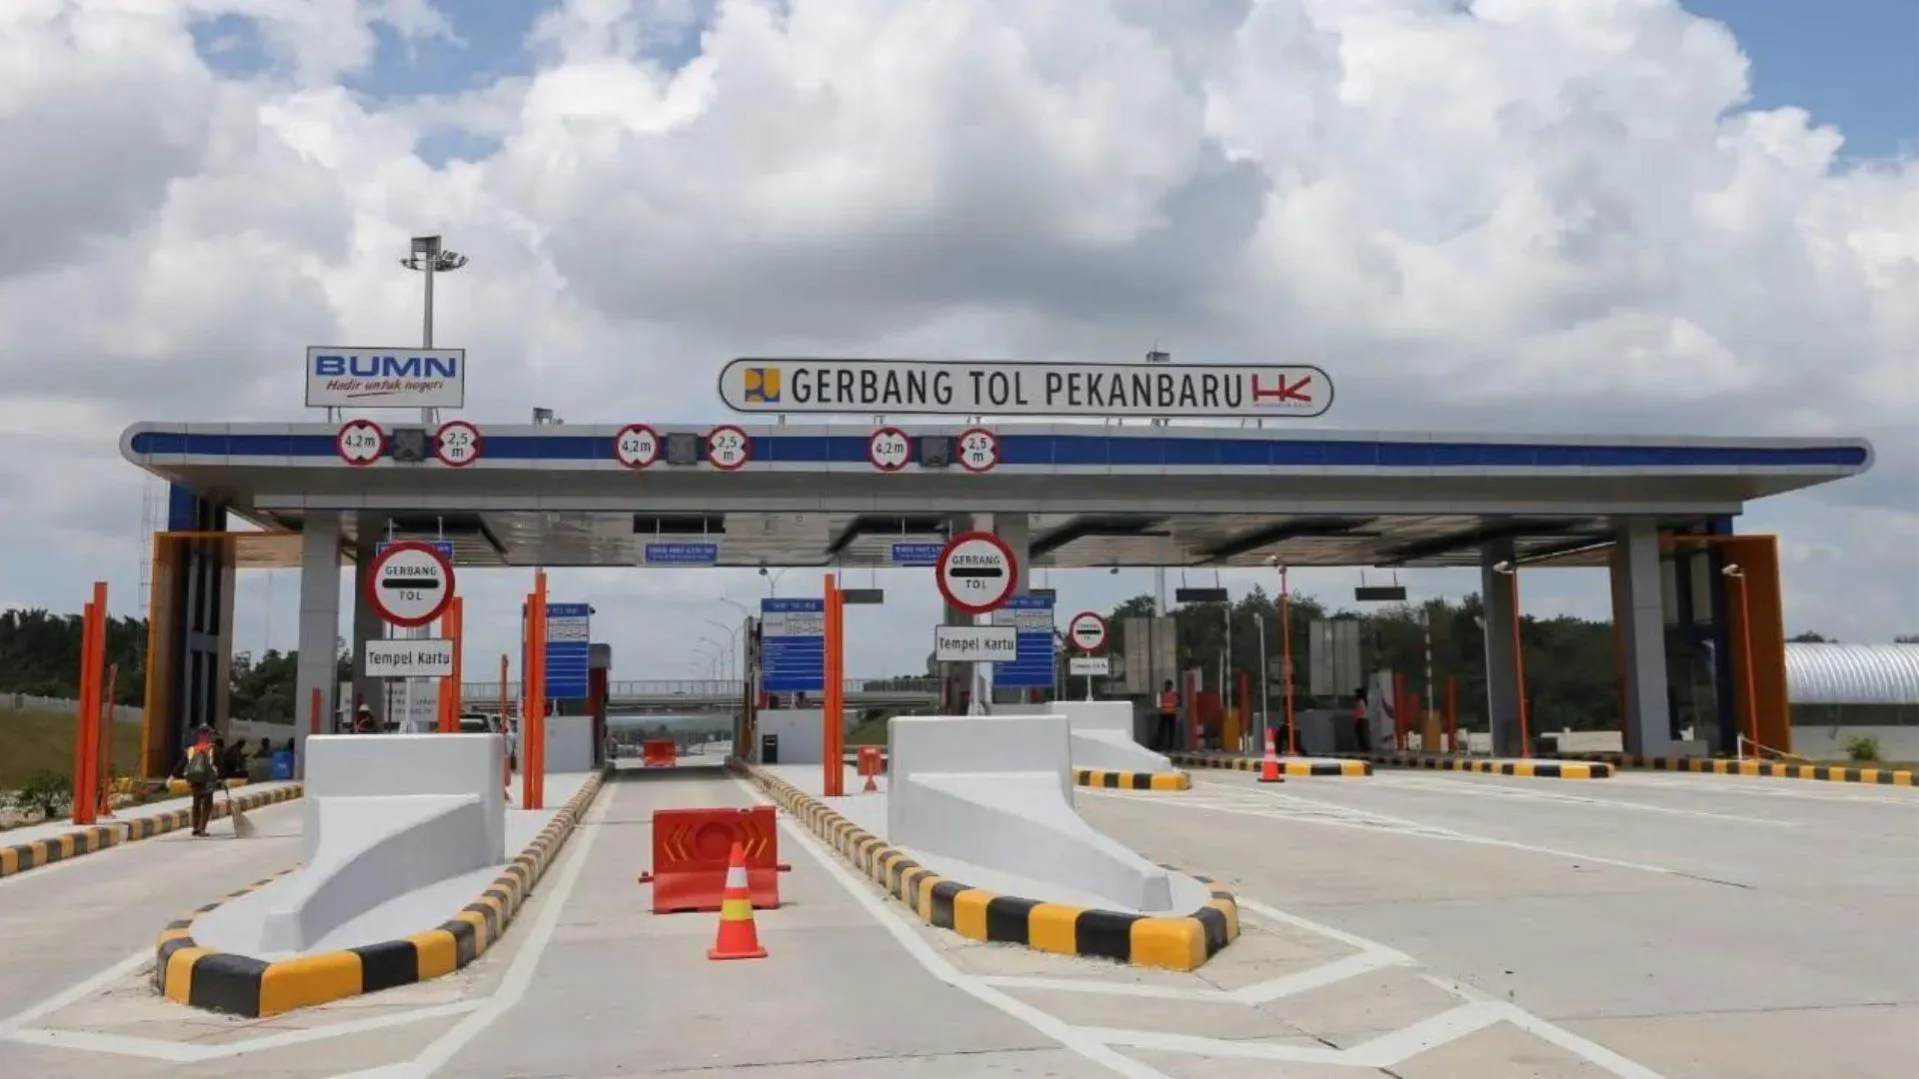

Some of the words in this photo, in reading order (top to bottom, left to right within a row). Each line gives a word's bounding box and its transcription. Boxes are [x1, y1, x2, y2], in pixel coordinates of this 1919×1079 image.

[316, 356, 456, 377] BUMN
[326, 380, 360, 391] Hadir
[364, 380, 400, 391] untuk
[405, 380, 444, 393] negeri
[791, 368, 953, 404] GERBANG
[969, 371, 1028, 405] TOL
[1045, 372, 1242, 408] PEKANBARU
[452, 448, 463, 457] m
[723, 451, 734, 461] m
[973, 453, 984, 463] m
[952, 555, 1000, 564] GERBANG
[385, 566, 437, 576] GERBANG
[966, 580, 986, 589] TOL
[400, 591, 423, 601] TOL
[939, 637, 979, 654] Tempel
[984, 639, 1014, 650] Kartu
[369, 651, 412, 667] Tempel
[418, 652, 450, 665] Kartu
